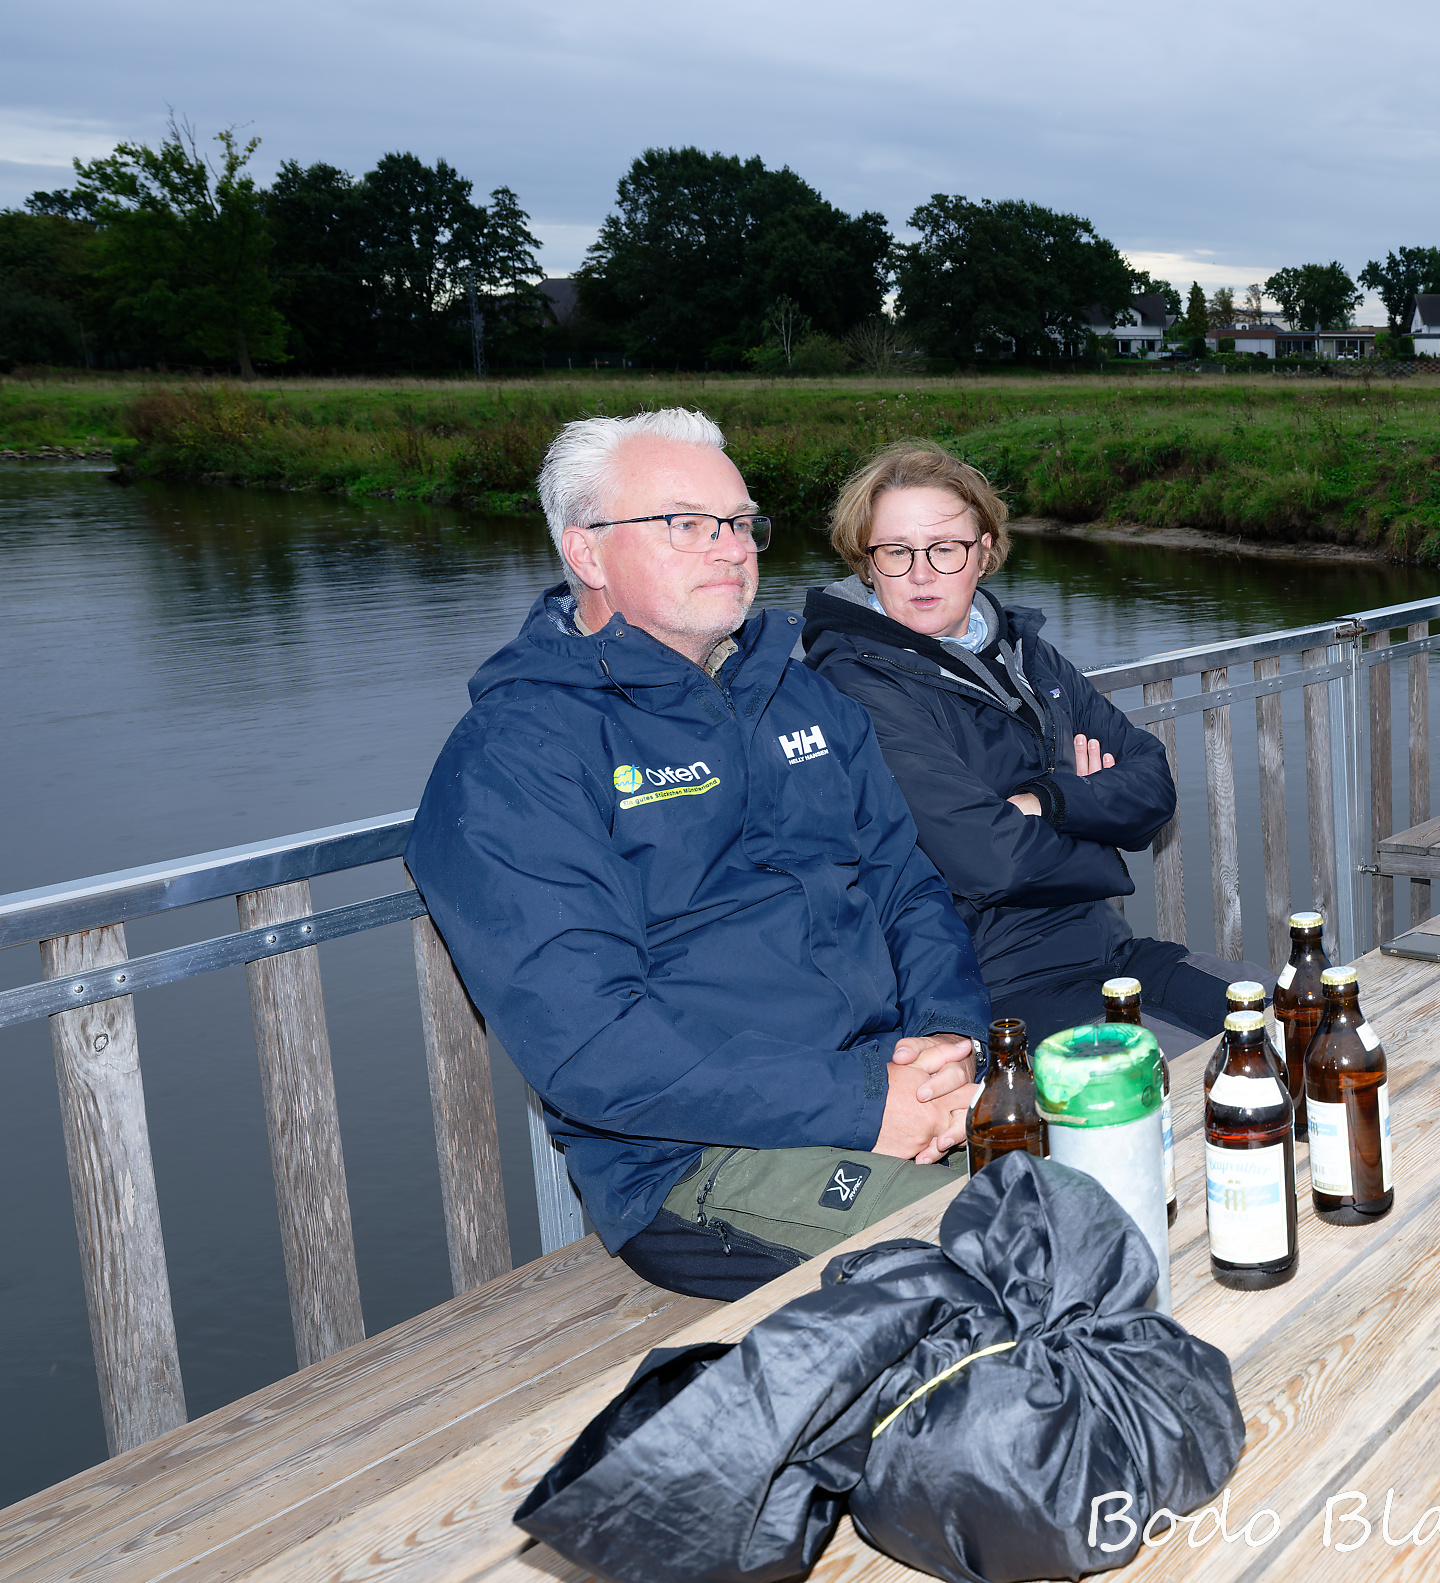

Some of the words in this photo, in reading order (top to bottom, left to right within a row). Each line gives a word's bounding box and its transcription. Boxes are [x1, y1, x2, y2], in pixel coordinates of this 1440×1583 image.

[777, 724, 828, 759] HH
[788, 756, 805, 765] HELLY
[804, 748, 829, 760] HANSEN
[645, 761, 712, 786] Olfen
